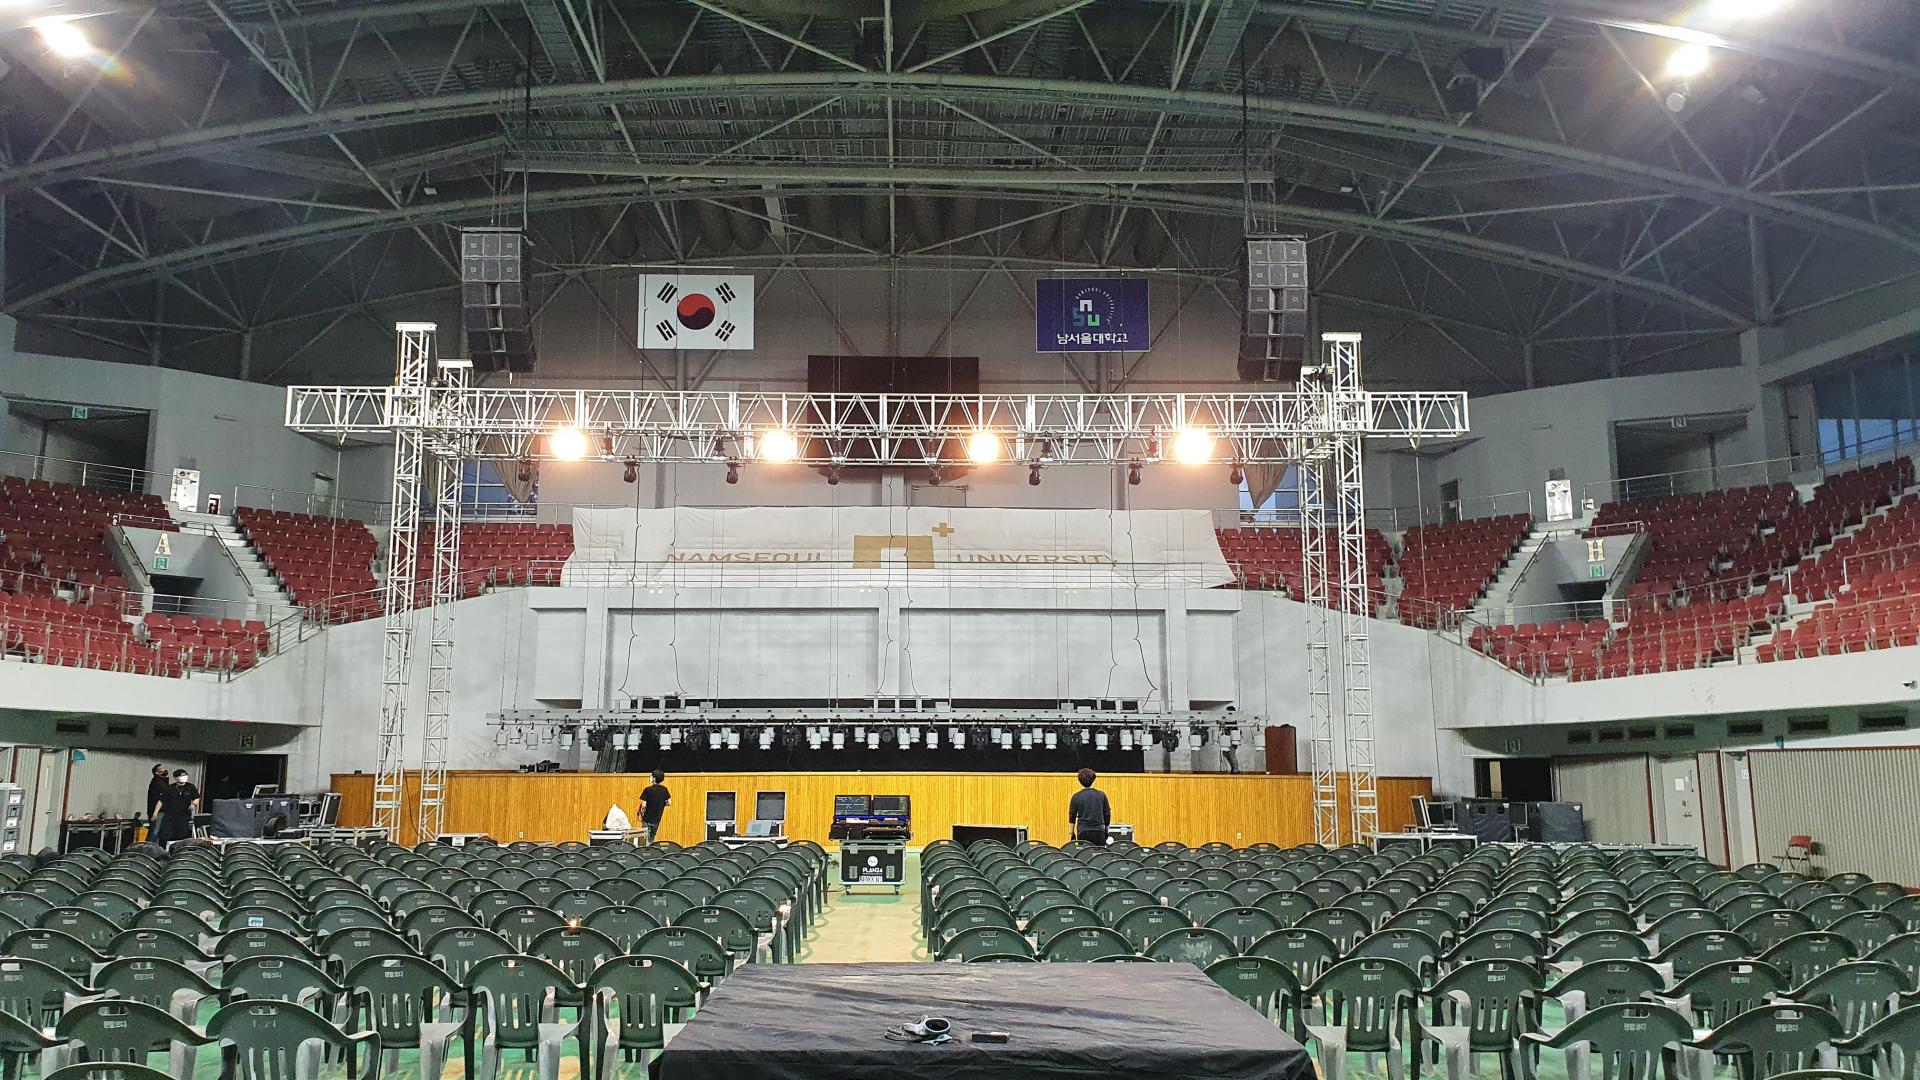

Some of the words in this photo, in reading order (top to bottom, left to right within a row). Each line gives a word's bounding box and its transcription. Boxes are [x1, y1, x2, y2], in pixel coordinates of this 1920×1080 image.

[1057, 333, 1128, 345] 남서울대학교
[154, 533, 172, 555] A
[1586, 539, 1606, 562] H
